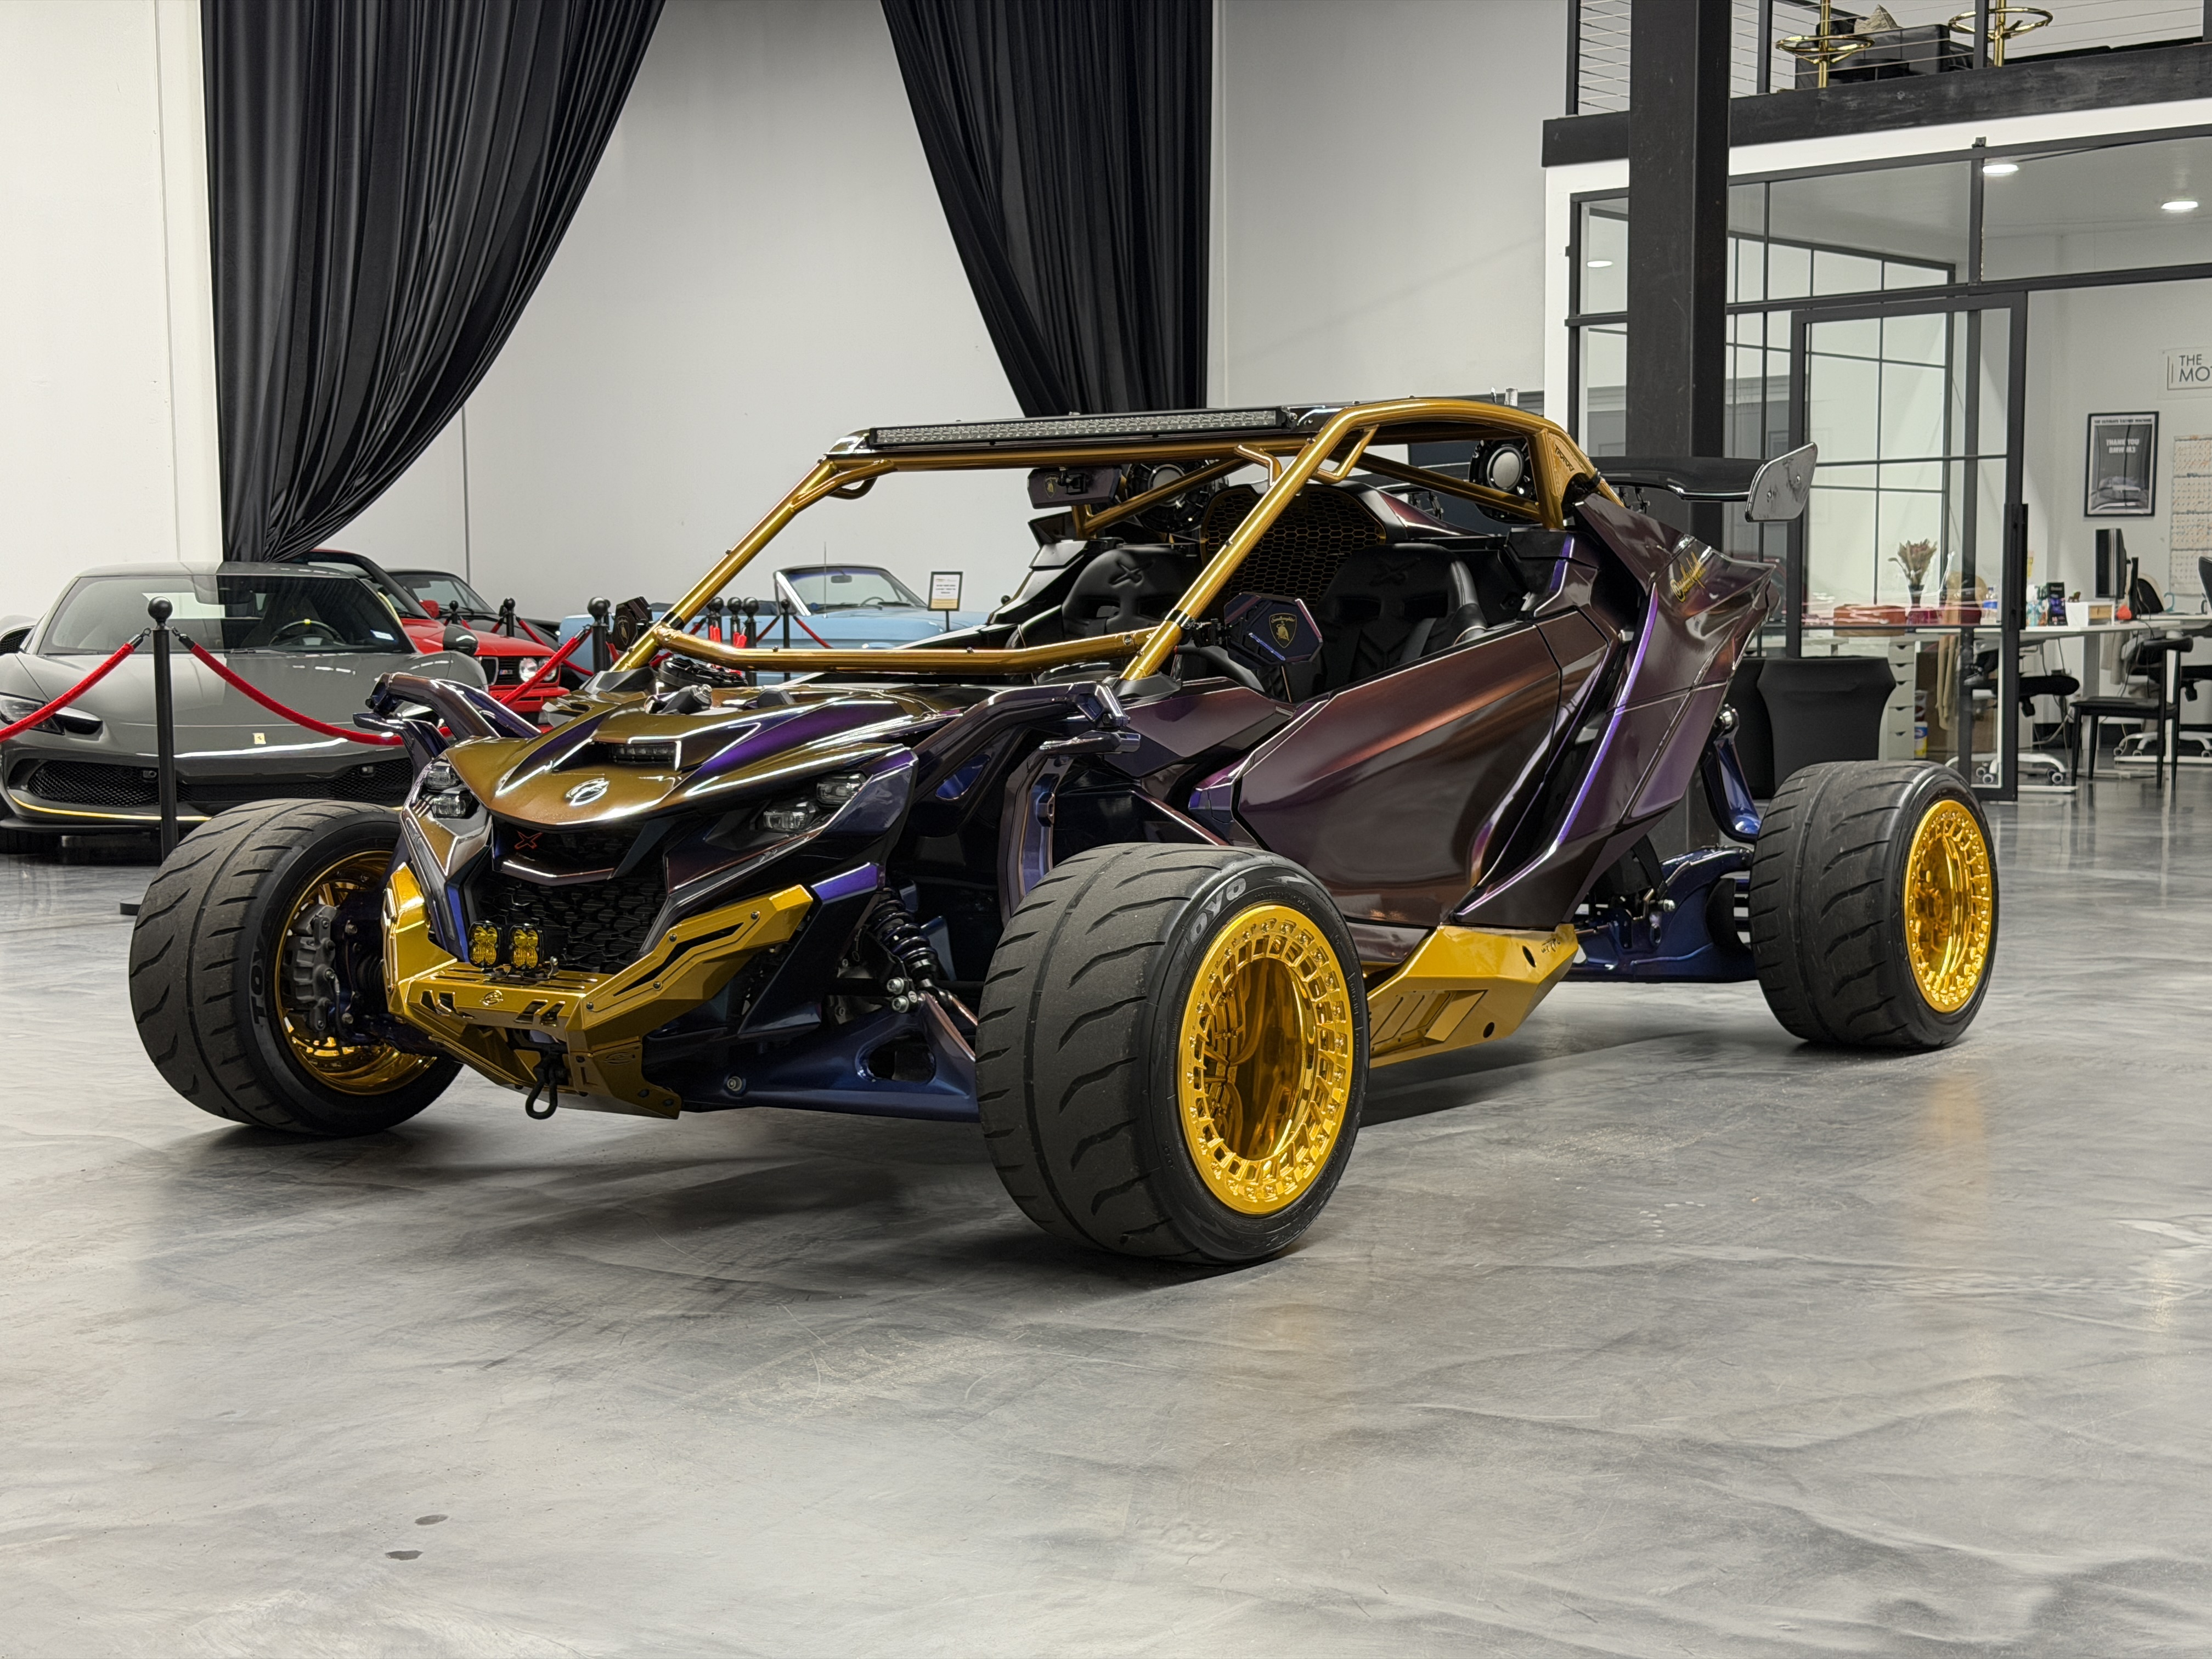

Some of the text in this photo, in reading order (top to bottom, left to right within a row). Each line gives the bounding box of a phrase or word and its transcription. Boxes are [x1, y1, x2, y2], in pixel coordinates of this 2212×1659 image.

[2179, 354, 2202, 366] THE
[2179, 366, 2212, 382] MO
[2106, 438, 2126, 447] THANK
